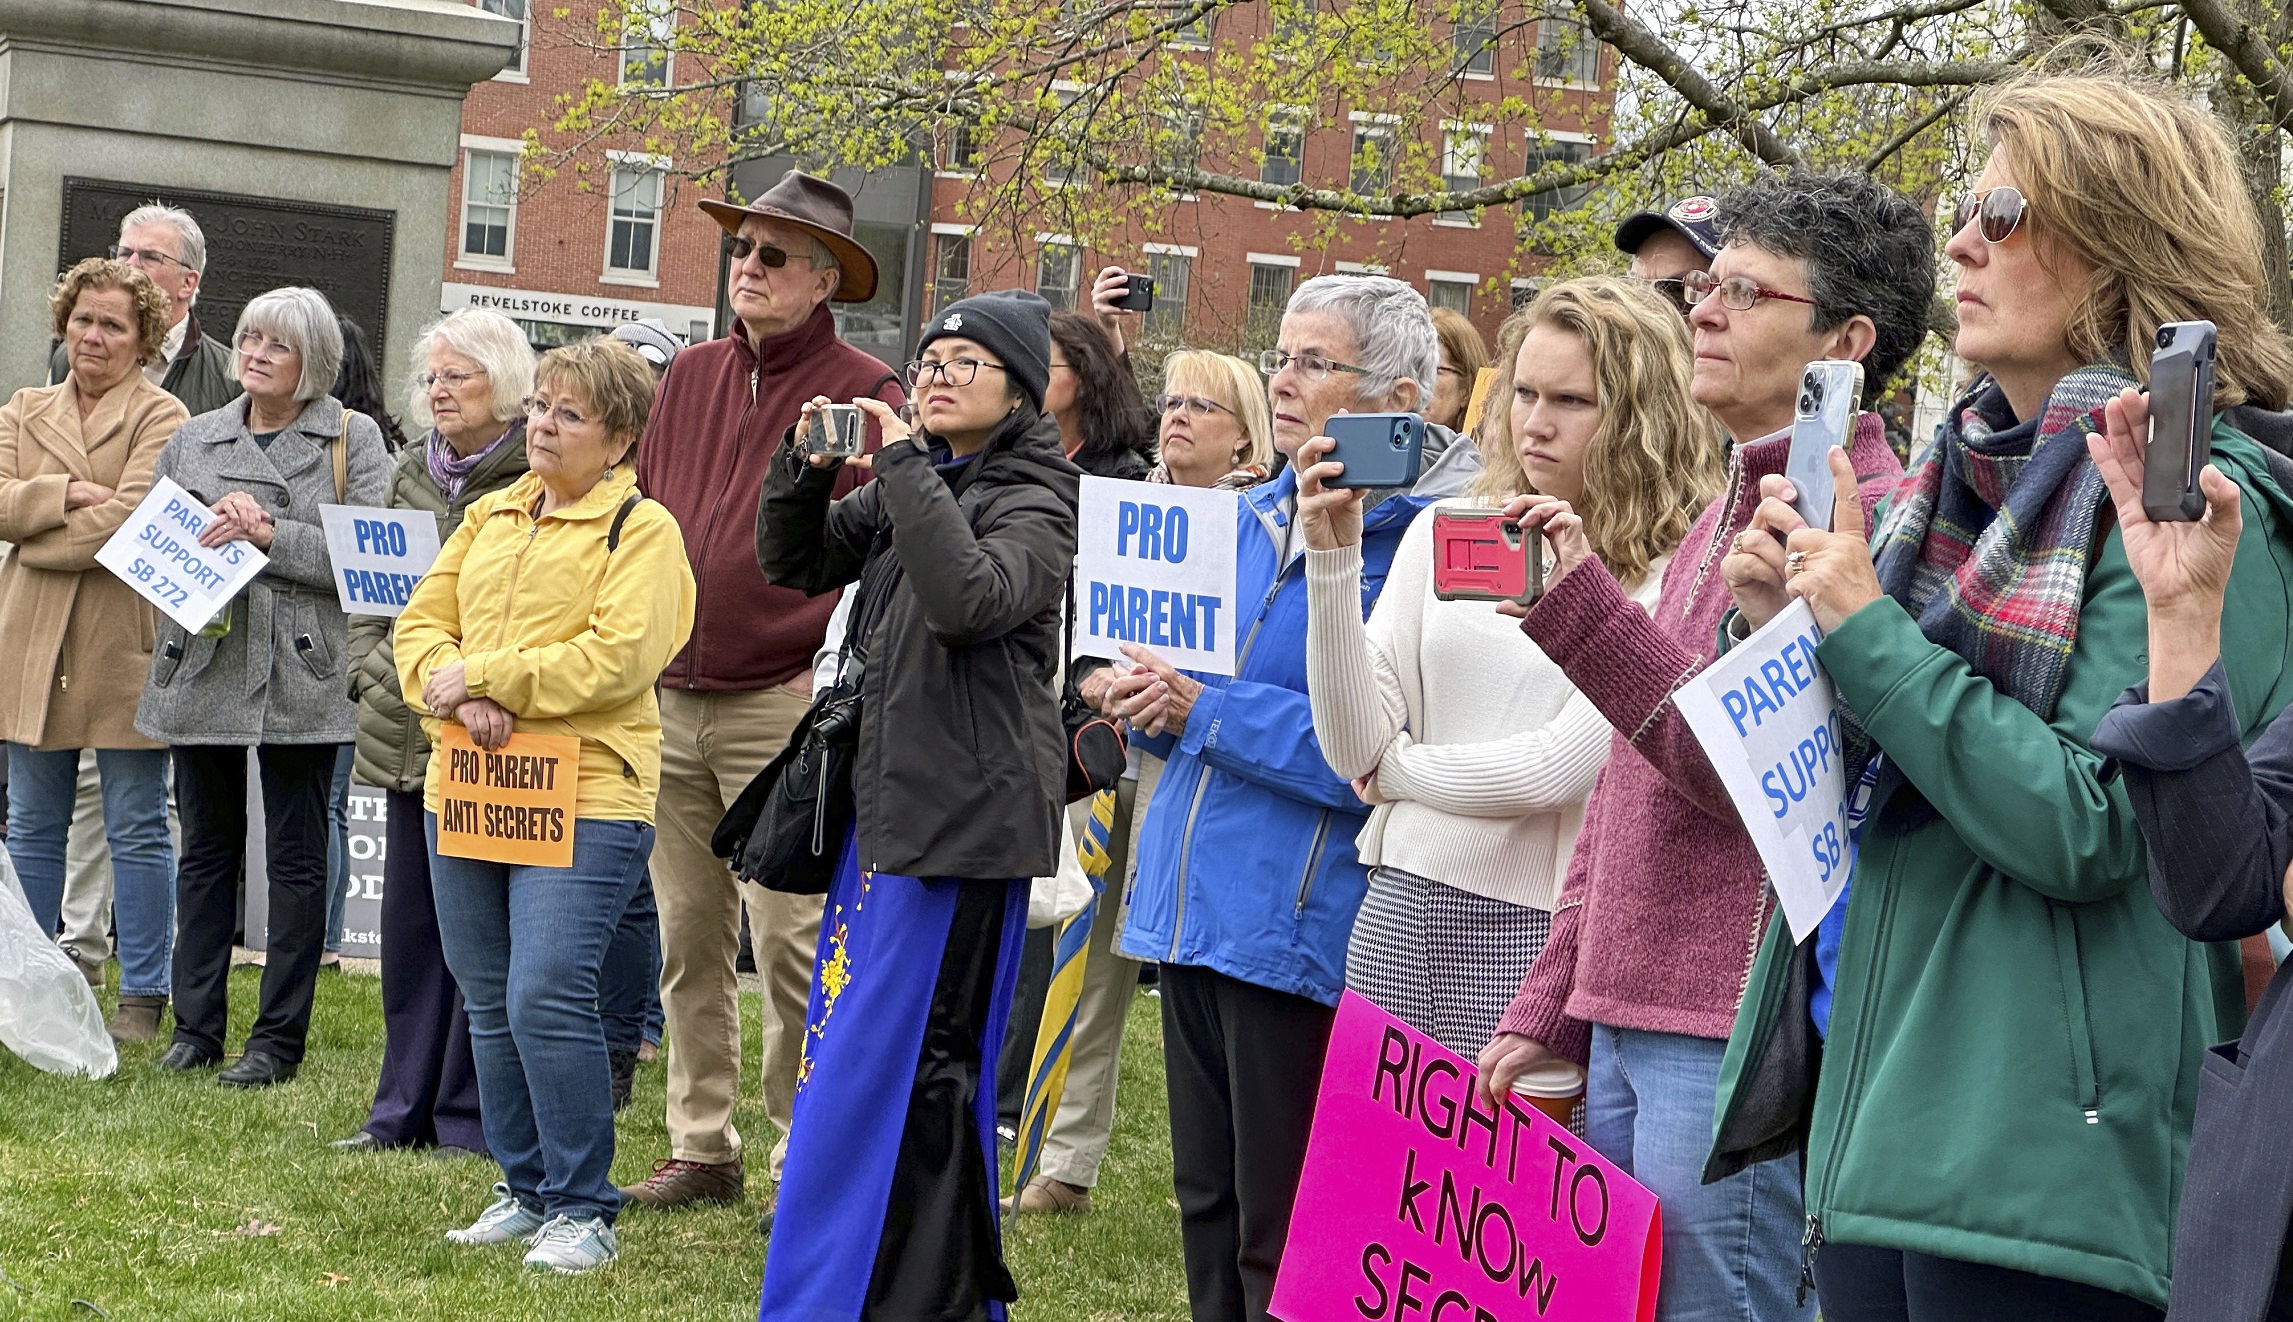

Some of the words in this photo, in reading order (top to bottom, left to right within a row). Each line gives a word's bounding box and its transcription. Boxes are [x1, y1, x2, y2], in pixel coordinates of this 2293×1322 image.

[203, 236, 308, 259] ONDONDERRY
[293, 220, 367, 248] STARK
[470, 294, 572, 316] REVELSTOKE
[581, 305, 640, 321] COFFEE
[139, 523, 225, 590] SUPPORT
[163, 498, 245, 565] PARTS
[353, 518, 407, 557] PRO
[1117, 500, 1189, 564] PRO
[127, 557, 156, 583] SB
[151, 575, 189, 609] 272
[343, 568, 423, 606] PAREN
[1089, 580, 1221, 652] PARENT
[1721, 624, 1820, 738] PAREN
[450, 748, 479, 785] PRO
[485, 752, 558, 790] PARENT
[1761, 708, 1841, 819] SUPPO
[443, 798, 478, 835] ANTI
[484, 803, 563, 842] SECRETS
[1812, 821, 1840, 883] SB
[1371, 1023, 1532, 1184] RIGHT
[1547, 1134, 1609, 1248] TO
